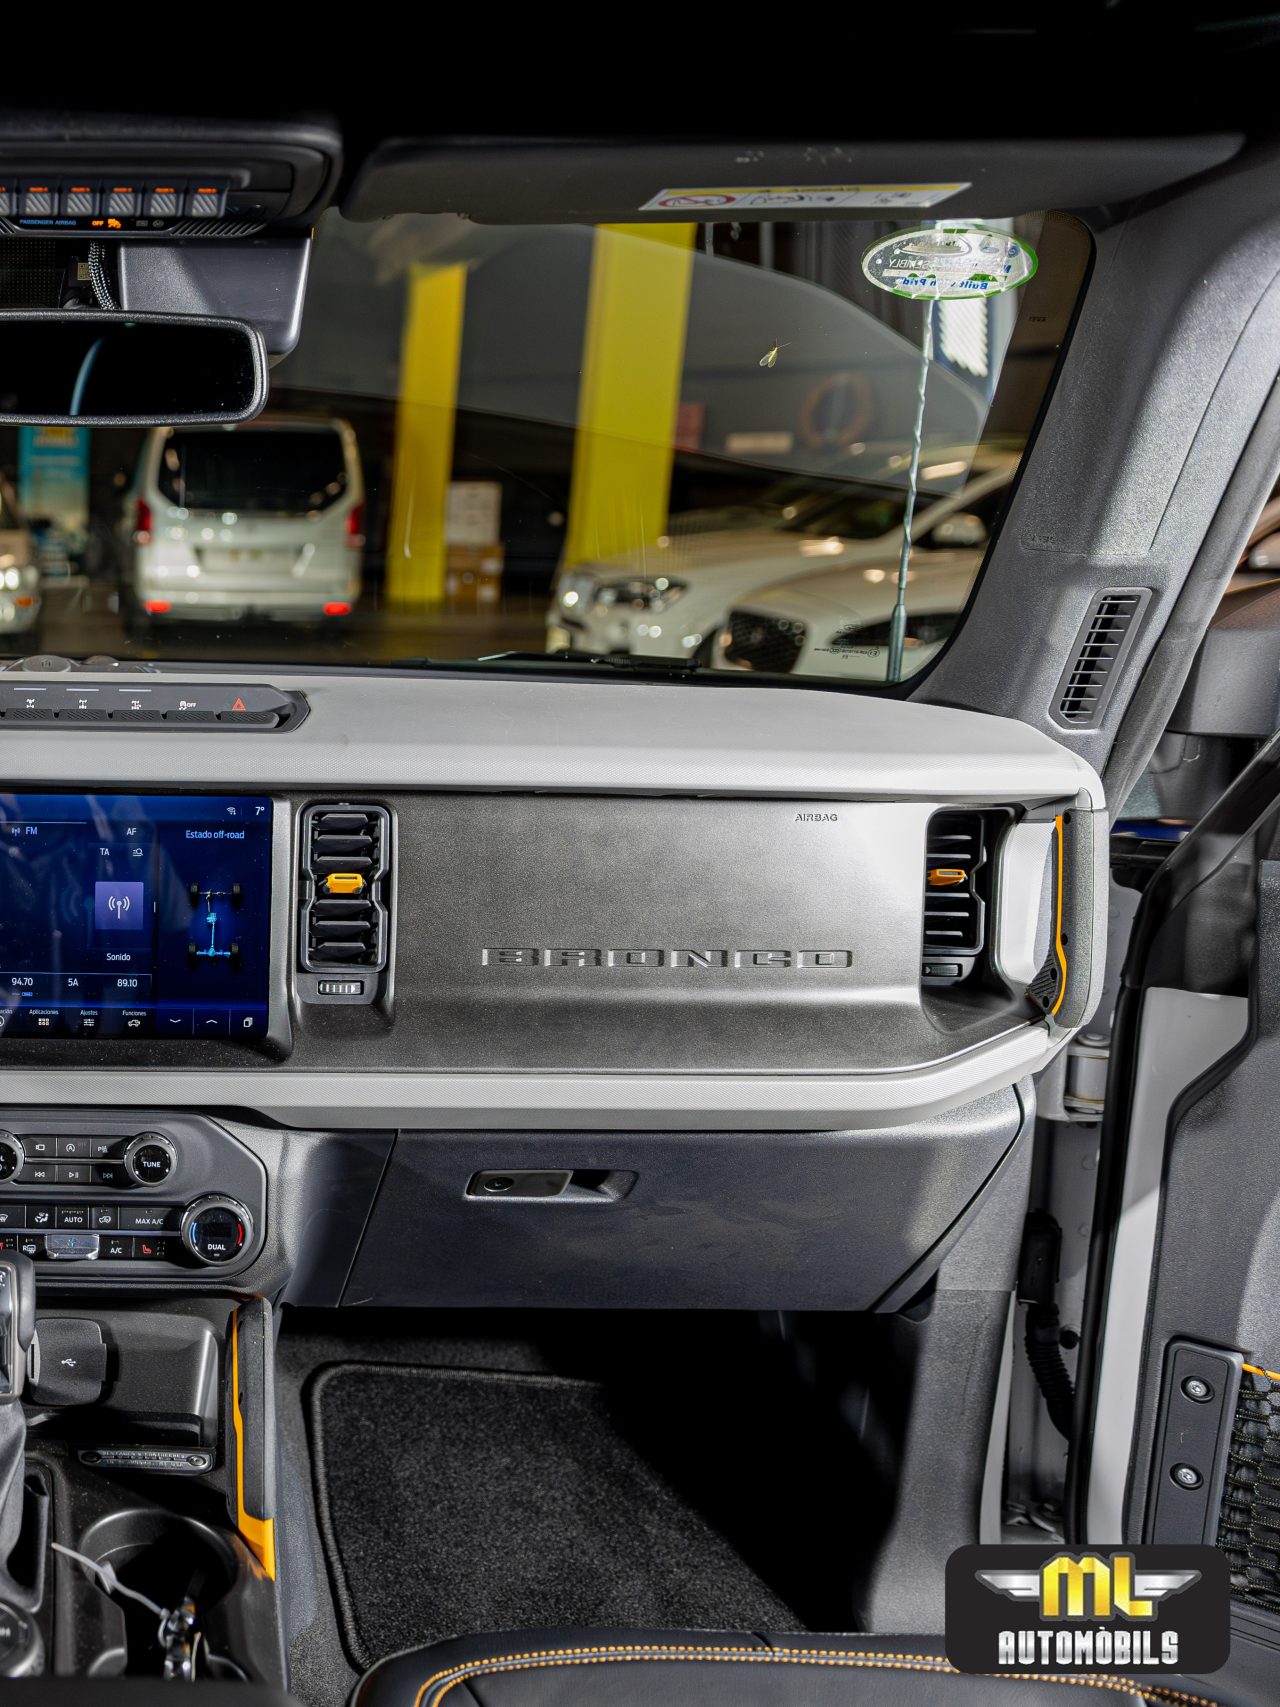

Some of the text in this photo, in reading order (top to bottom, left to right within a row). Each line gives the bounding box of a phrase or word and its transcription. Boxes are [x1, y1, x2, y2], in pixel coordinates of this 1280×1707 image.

[255, 806, 265, 816] 7°
[794, 813, 838, 822] AIRBAG
[25, 826, 38, 835] FM
[126, 827, 137, 836] AF
[185, 830, 245, 839] Estado off-road
[100, 847, 110, 856] TA
[106, 952, 131, 961] Sonido
[481, 947, 853, 969] BRONCO
[11, 977, 34, 986] 94.70
[67, 978, 79, 987] 5A
[117, 978, 138, 988] 89.10
[80, 1009, 98, 1017] Ajustes
[122, 1009, 147, 1017] Funciones
[207, 1243, 226, 1251] DUAL
